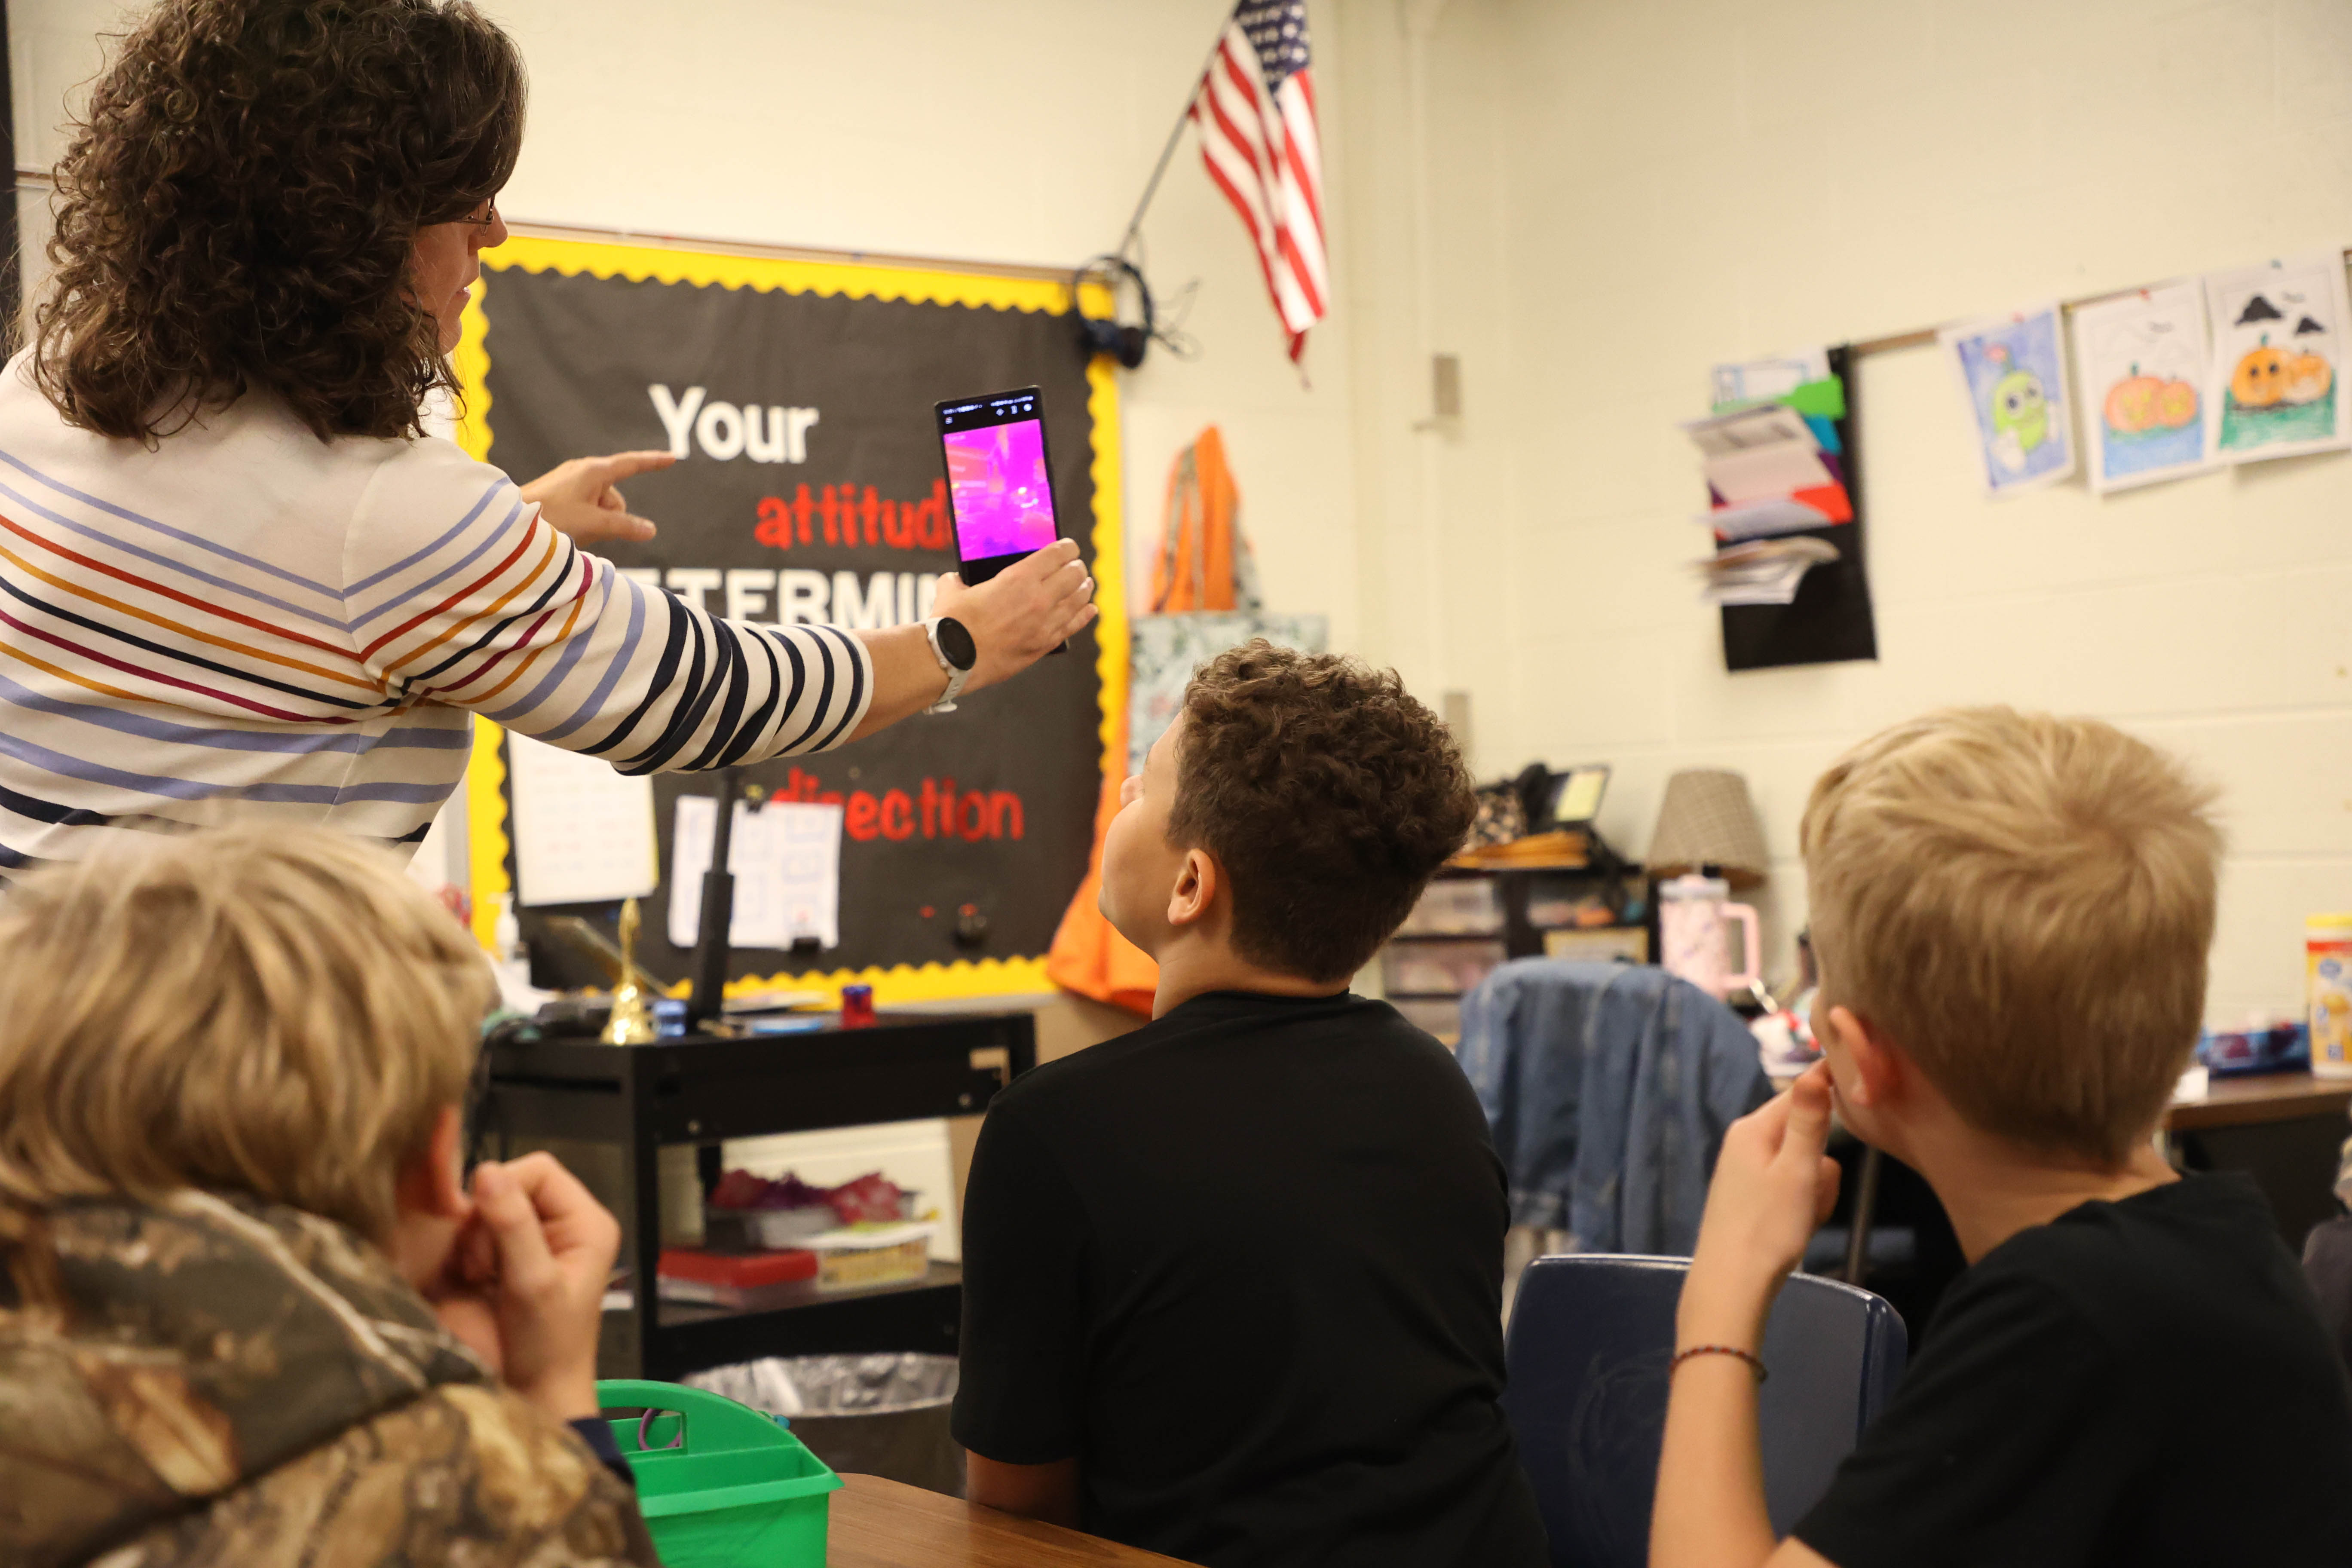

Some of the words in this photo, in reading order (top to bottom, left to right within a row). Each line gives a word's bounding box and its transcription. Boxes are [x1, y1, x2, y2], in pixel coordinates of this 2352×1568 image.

[648, 383, 820, 463] Your
[754, 477, 953, 551] attitud
[616, 567, 939, 627] TERMI
[771, 766, 1025, 842] ection
